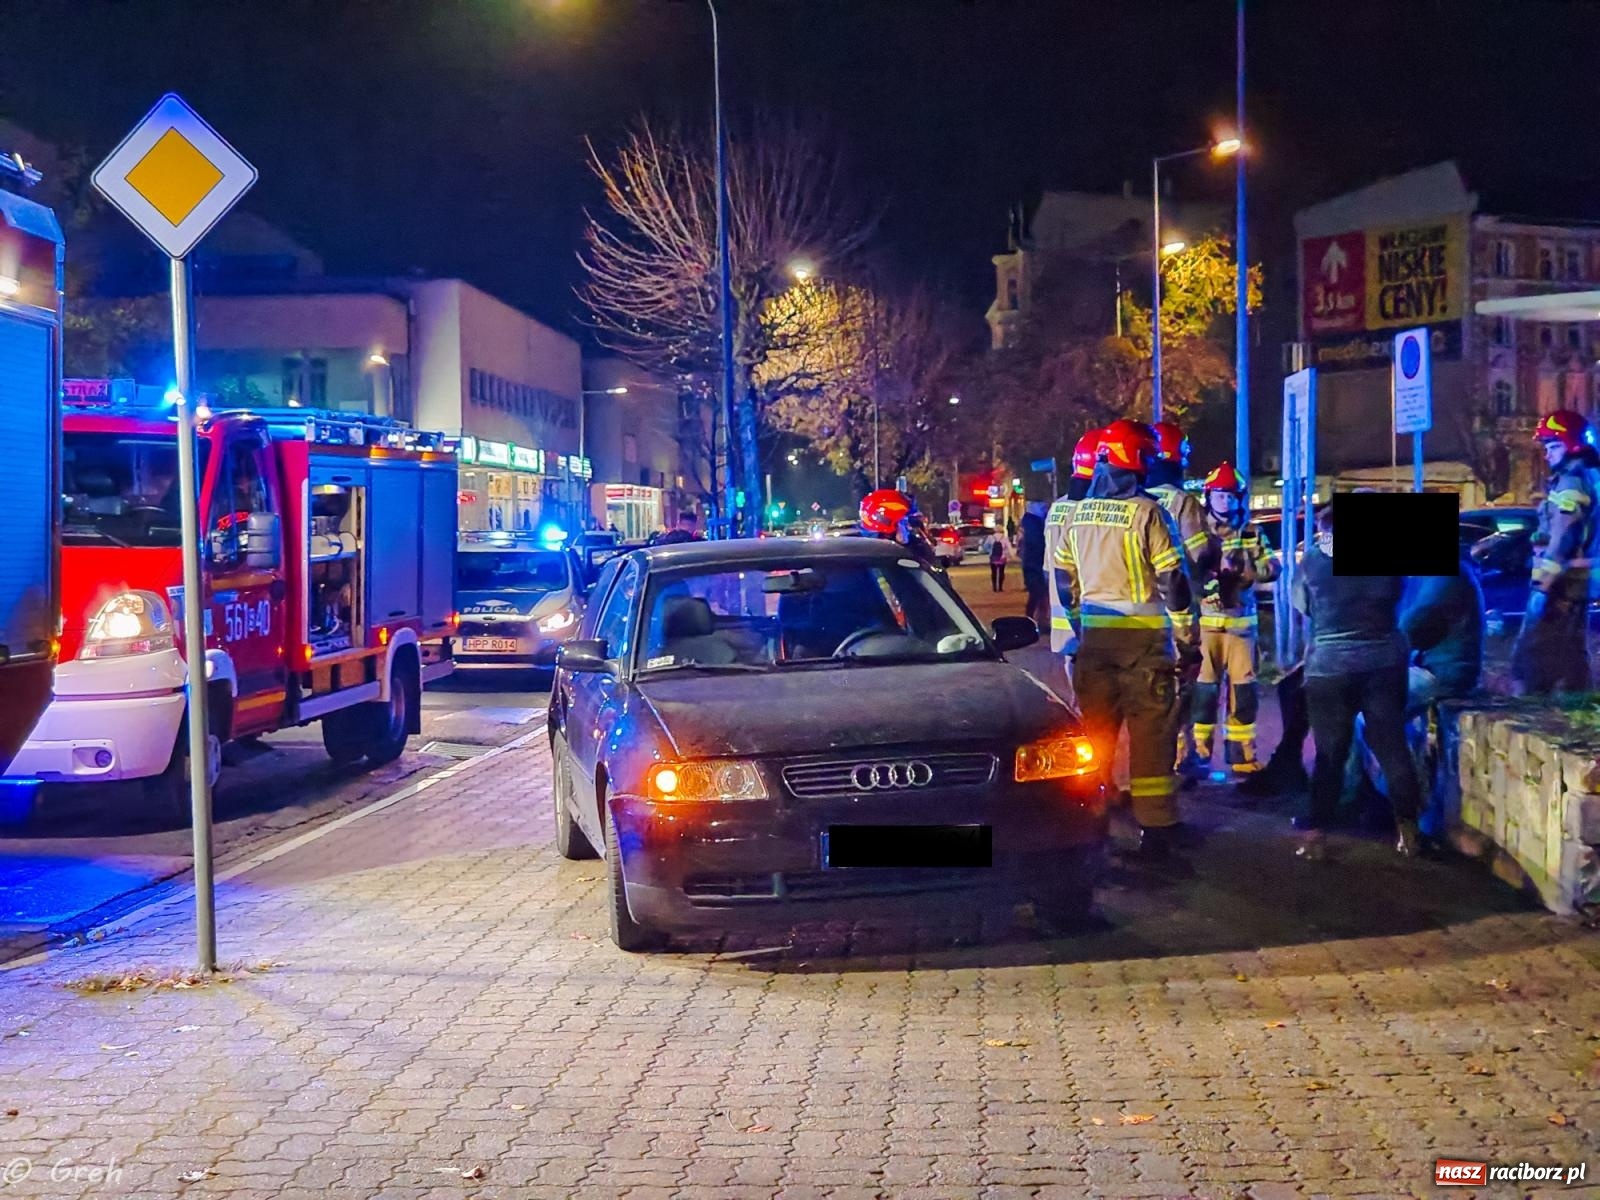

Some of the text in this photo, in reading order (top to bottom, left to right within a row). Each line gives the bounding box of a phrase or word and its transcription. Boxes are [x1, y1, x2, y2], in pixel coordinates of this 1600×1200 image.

[1380, 277, 1448, 320] CENY!
[463, 606, 520, 614] POLICJA
[468, 639, 489, 649] HPP
